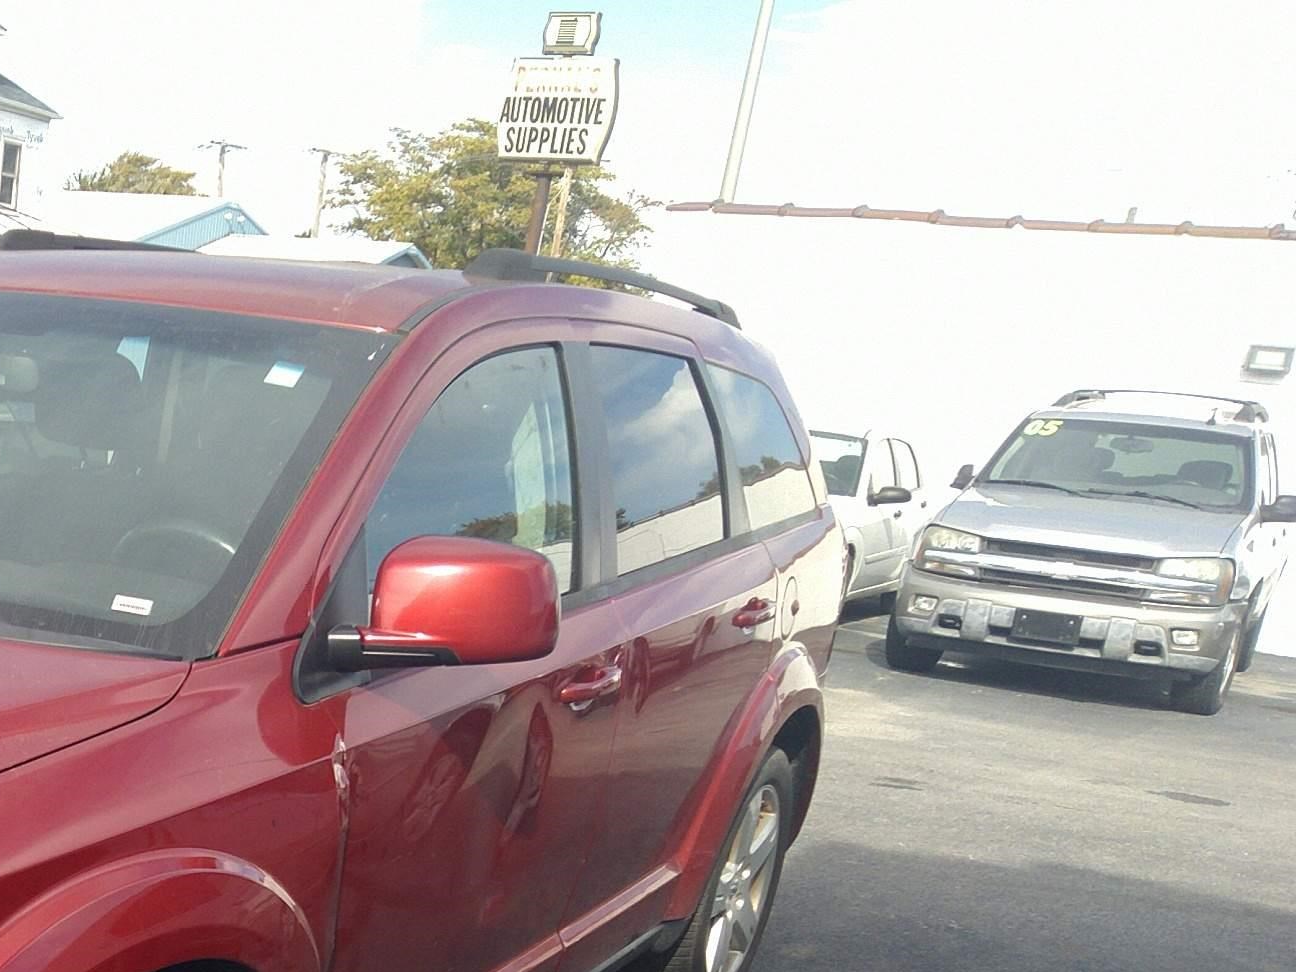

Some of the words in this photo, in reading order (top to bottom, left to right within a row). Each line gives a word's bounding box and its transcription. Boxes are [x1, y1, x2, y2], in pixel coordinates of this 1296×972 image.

[500, 96, 606, 125] AUTOMOTIVE
[504, 127, 589, 155] SUPPLIES
[1023, 419, 1064, 436] 05
